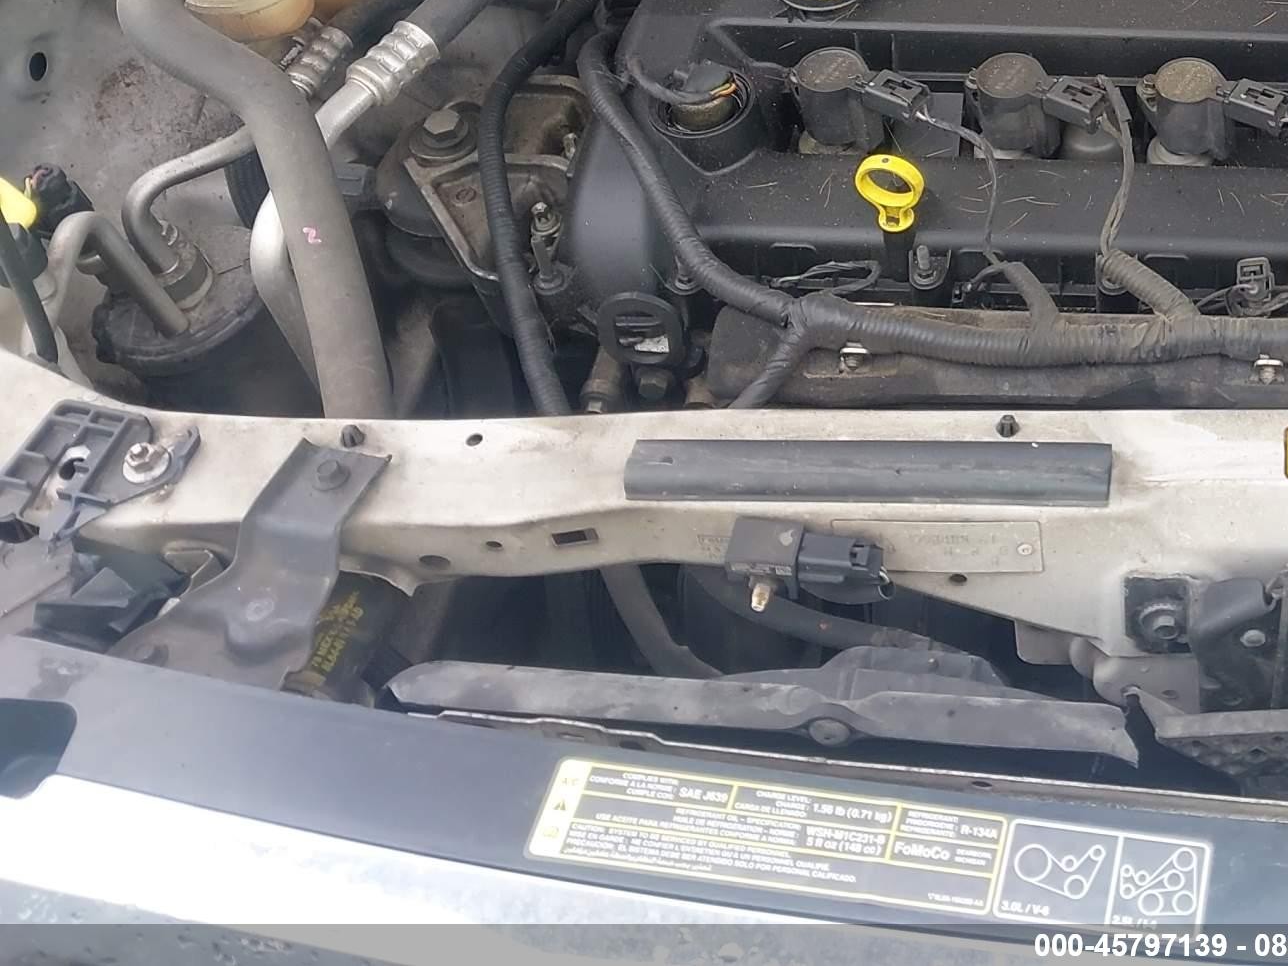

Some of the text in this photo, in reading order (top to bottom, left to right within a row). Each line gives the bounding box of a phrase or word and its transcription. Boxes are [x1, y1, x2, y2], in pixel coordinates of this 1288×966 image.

[678, 787, 728, 803] SAE J639
[834, 806, 845, 816] lb
[874, 810, 893, 824] kg)
[960, 824, 998, 838] R-134A
[805, 836, 814, 846] 5
[823, 839, 837, 849] oz
[893, 841, 951, 860] FoMoCo
